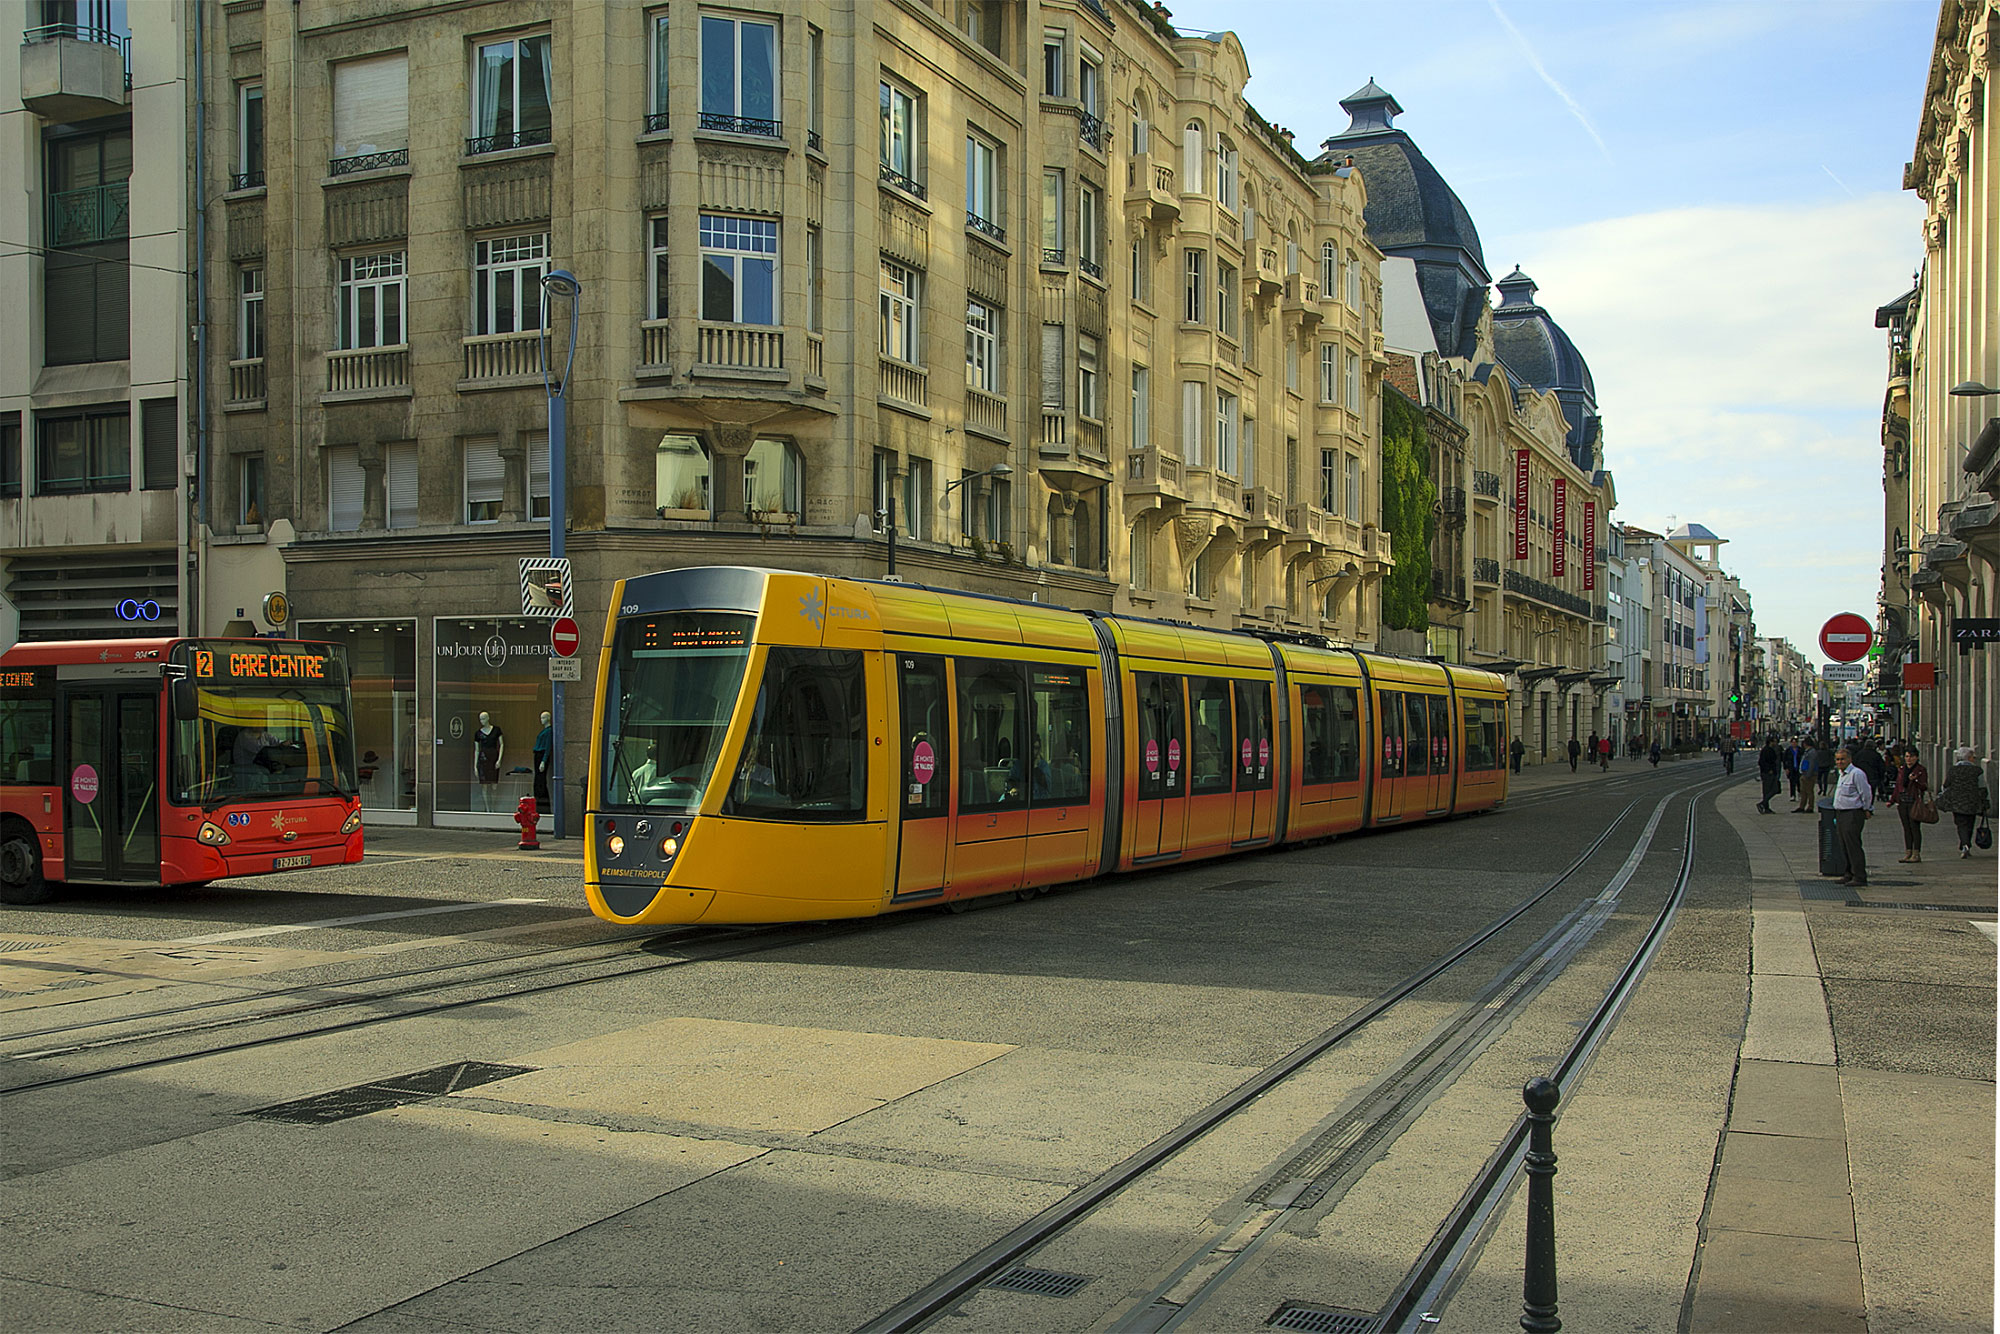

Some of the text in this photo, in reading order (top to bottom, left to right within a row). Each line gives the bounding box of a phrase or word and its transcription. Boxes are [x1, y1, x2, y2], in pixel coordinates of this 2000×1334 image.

[1518, 455, 1528, 554] GALERIES LAFAYETTE
[1555, 484, 1564, 572] GALERIES LAFAYETTE
[621, 604, 639, 615] 109
[828, 606, 871, 620] CITURA
[1956, 629, 2000, 638] ZARA
[437, 645, 453, 656] UN
[453, 641, 482, 658] JOUR
[510, 644, 553, 656] AILLEUR
[198, 652, 325, 678] 2 GARE CENTRE
[904, 660, 915, 669] 109
[5, 672, 35, 687] CENTRE
[284, 816, 308, 824] CITURA
